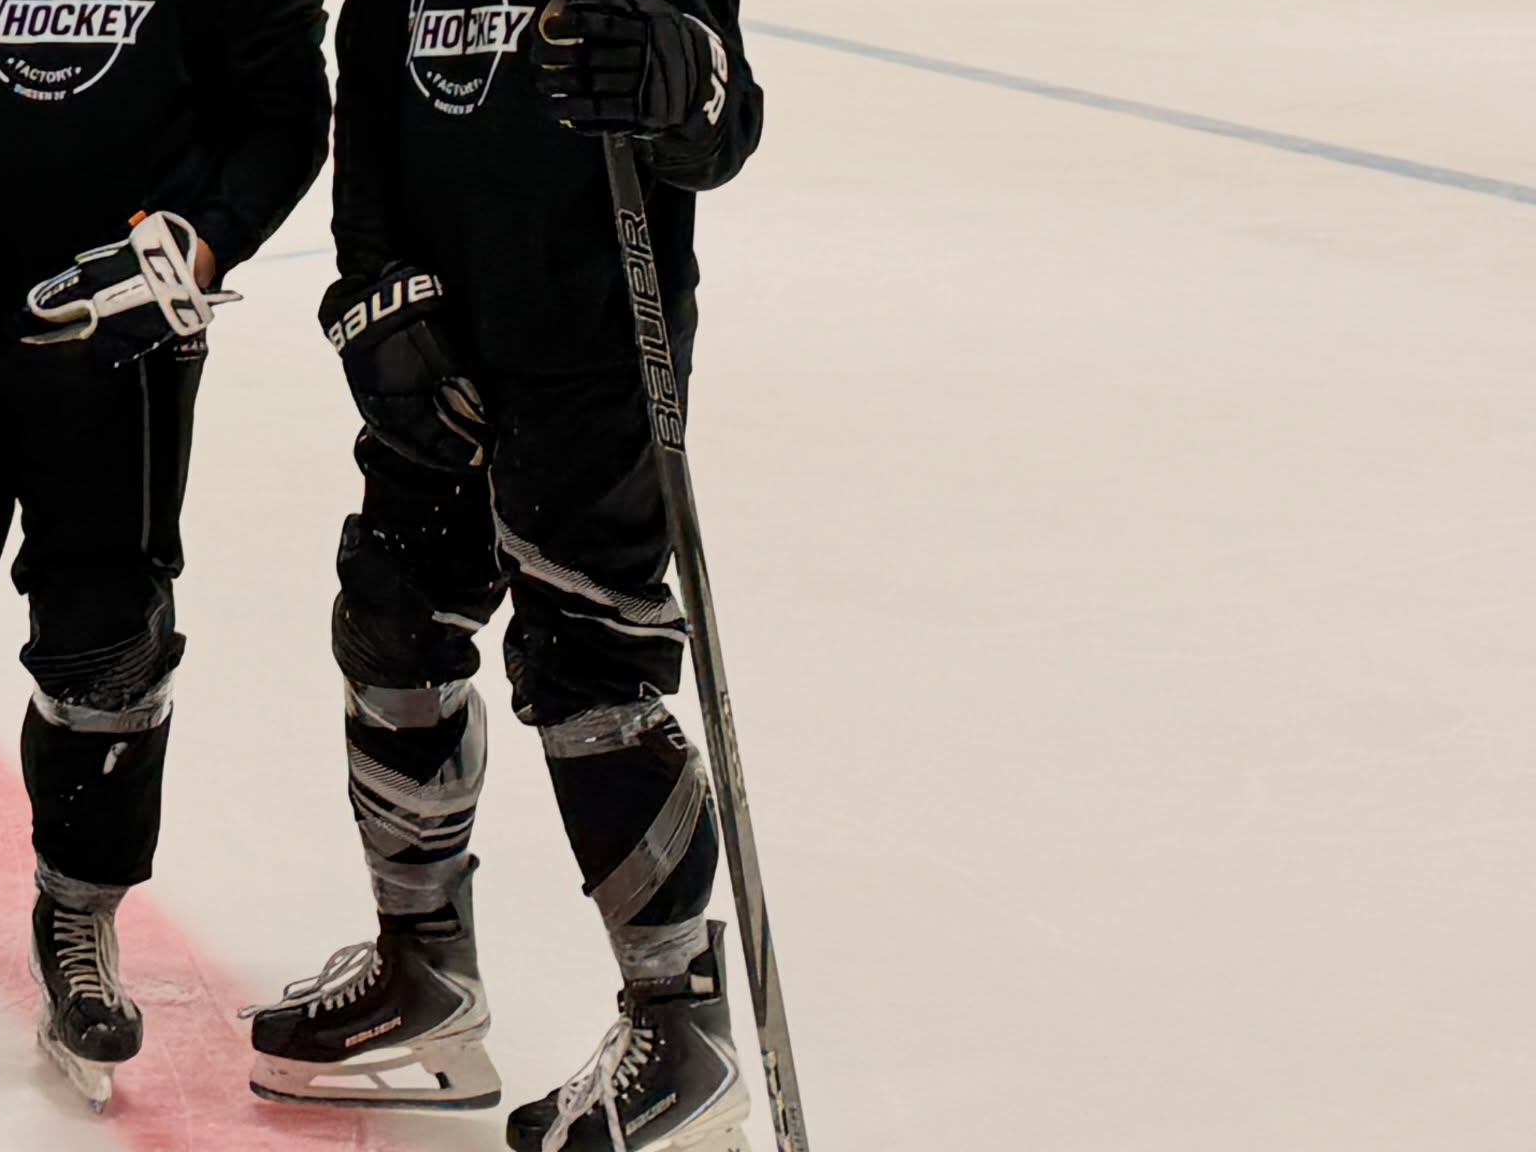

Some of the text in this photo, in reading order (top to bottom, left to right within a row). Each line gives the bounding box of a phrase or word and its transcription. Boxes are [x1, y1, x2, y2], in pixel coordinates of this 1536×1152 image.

[1, 3, 148, 37] HOCKEY
[420, 10, 527, 50] HOCKEY
[15, 59, 73, 84] FACTORY
[328, 273, 444, 354] BAUE
[615, 208, 686, 453] BAUER
